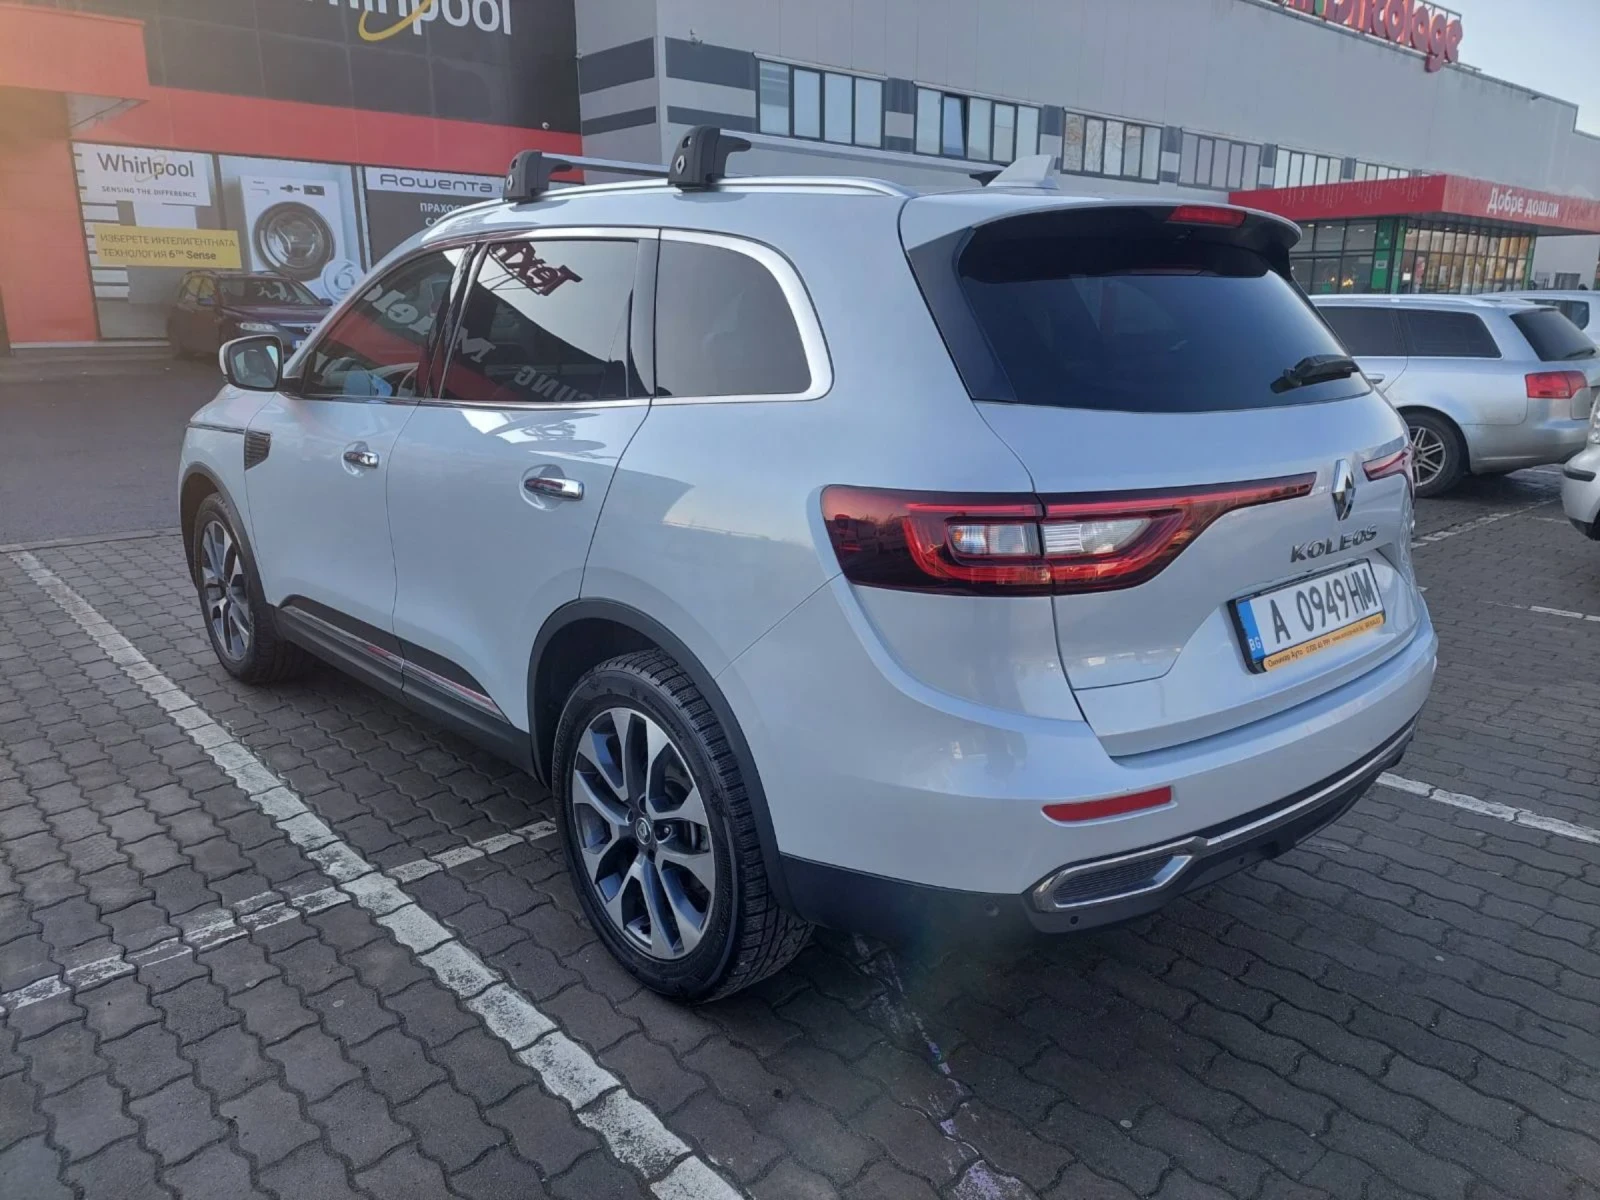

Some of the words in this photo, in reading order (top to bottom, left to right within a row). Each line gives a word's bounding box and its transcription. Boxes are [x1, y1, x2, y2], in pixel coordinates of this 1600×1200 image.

[97, 152, 195, 180] Whirlpool
[101, 185, 135, 194] SENSING
[136, 187, 151, 196] THE
[153, 188, 197, 198] DIFFERENCE
[380, 173, 493, 193] Rowenta
[1486, 187, 1524, 217] Добре
[1524, 198, 1560, 219] дошли
[100, 233, 150, 245] ИЗБЕРЕТЕ
[151, 235, 236, 247] ИНТЕЛИГЕНТНАТА
[103, 247, 168, 259] ТЕХНОЛОГИЯ
[186, 250, 217, 260] Sense
[1290, 523, 1377, 563] KOLEOS
[1270, 599, 1292, 644] A
[1248, 636, 1262, 651] BG
